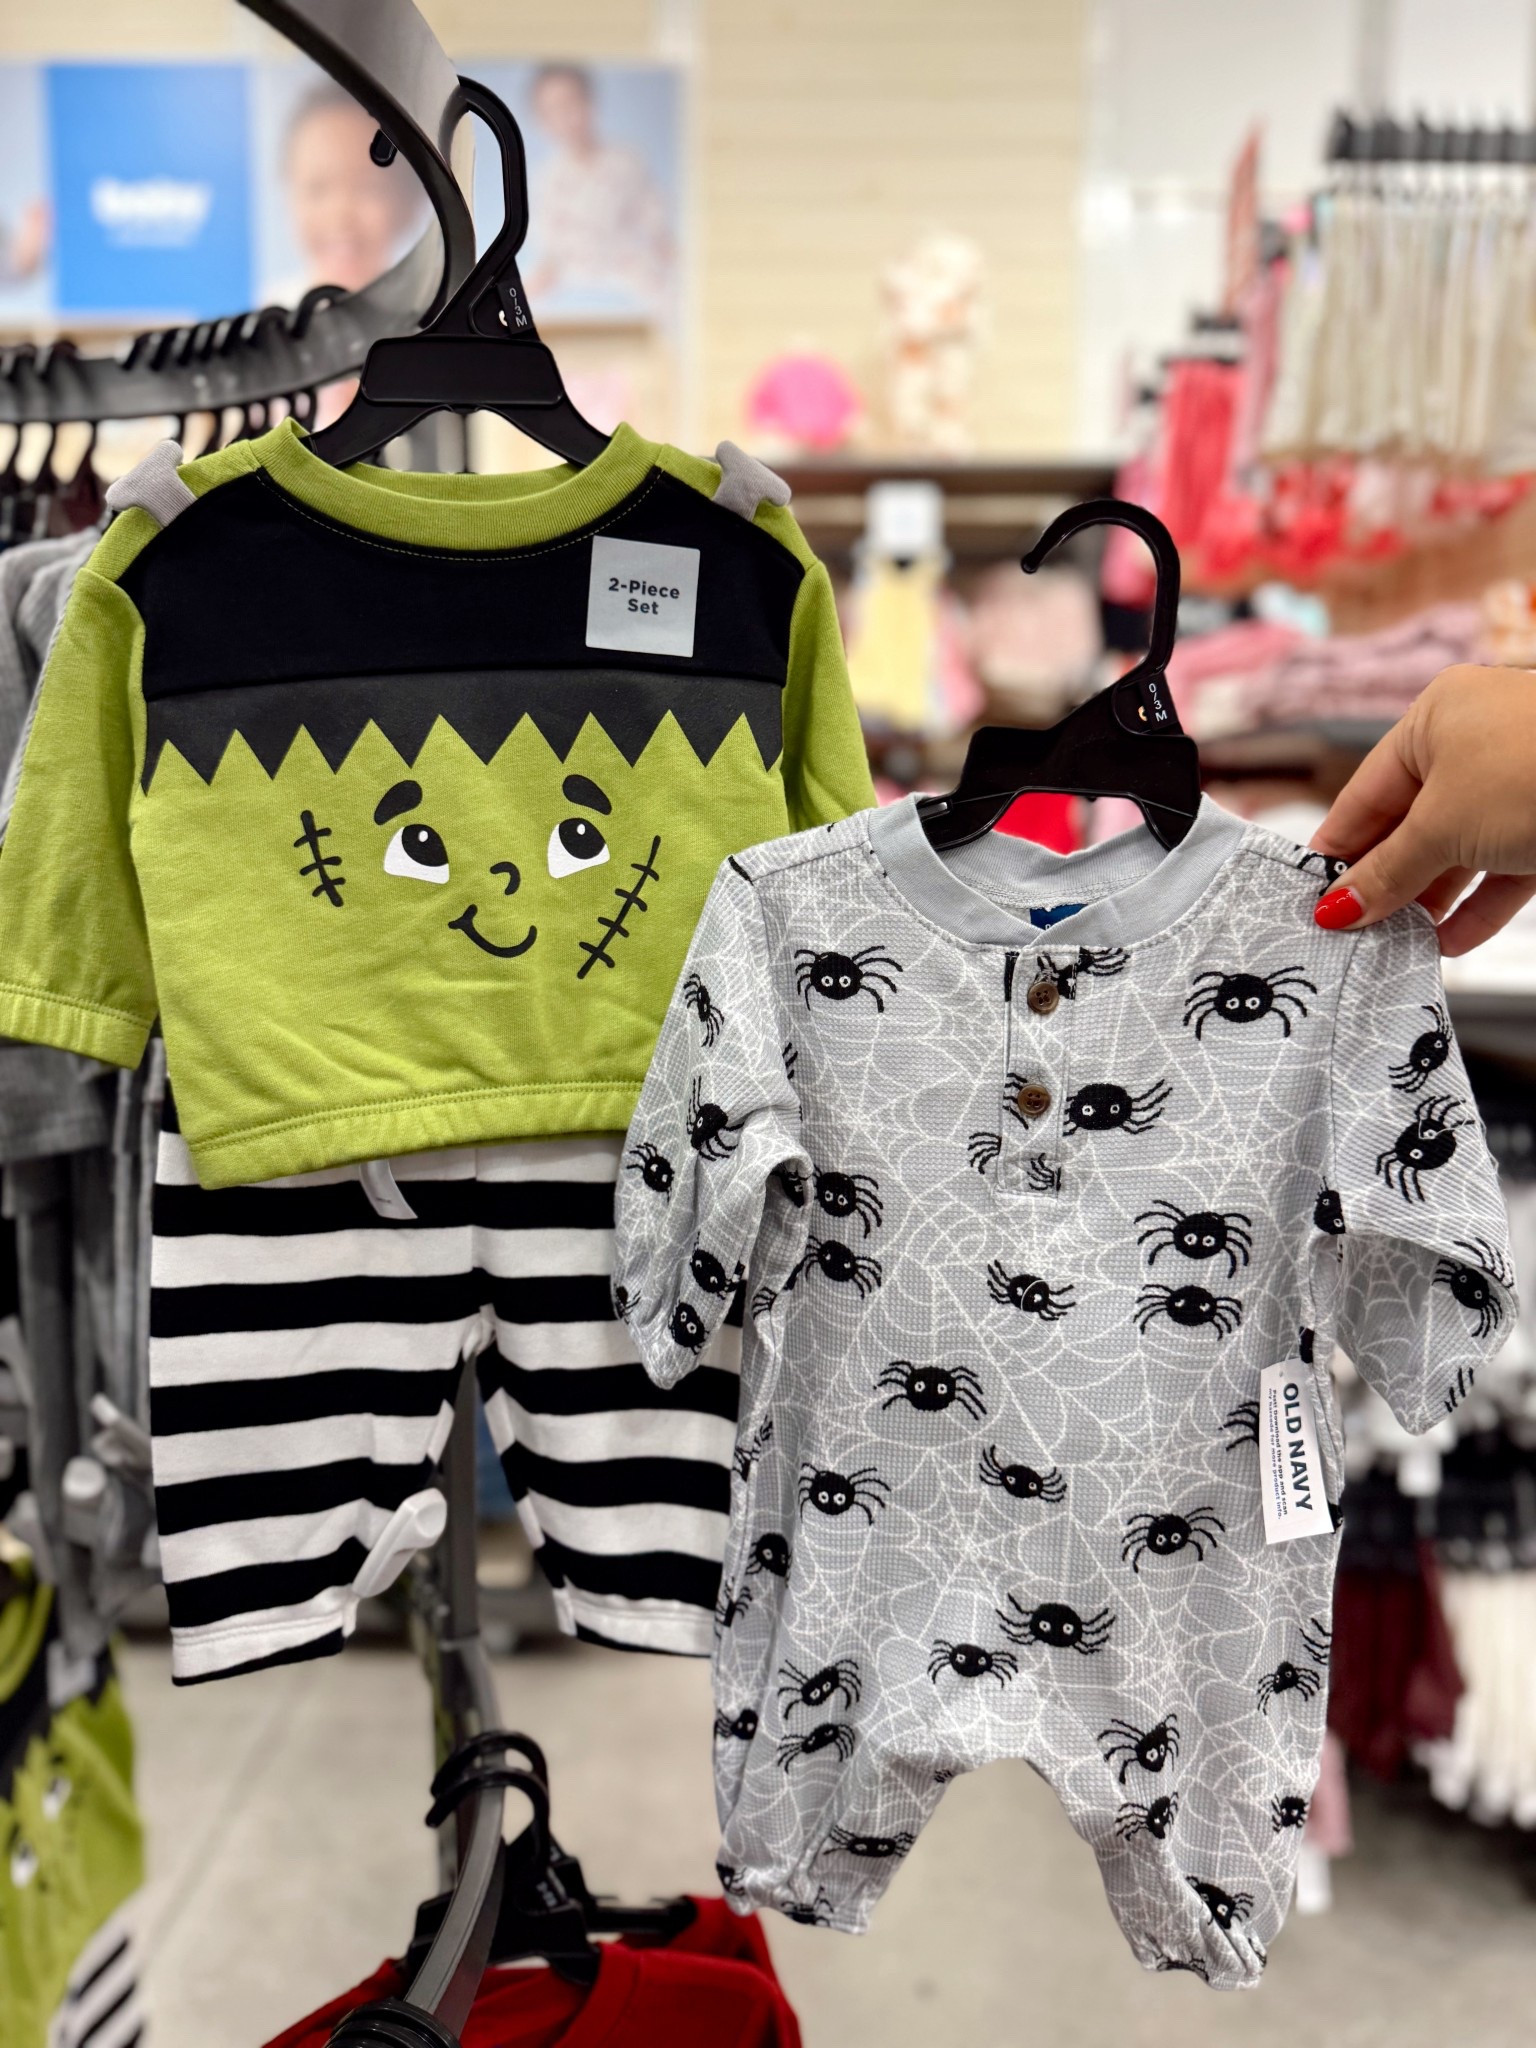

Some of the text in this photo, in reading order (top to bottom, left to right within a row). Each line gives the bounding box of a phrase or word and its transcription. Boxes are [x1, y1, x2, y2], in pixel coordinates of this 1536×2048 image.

[608, 577, 680, 599] 2-Piece
[628, 598, 659, 615] Set
[1273, 1409, 1281, 1448] Download
[1283, 1383, 1313, 1511] OLD NAVY
[1272, 1469, 1280, 1500] product
